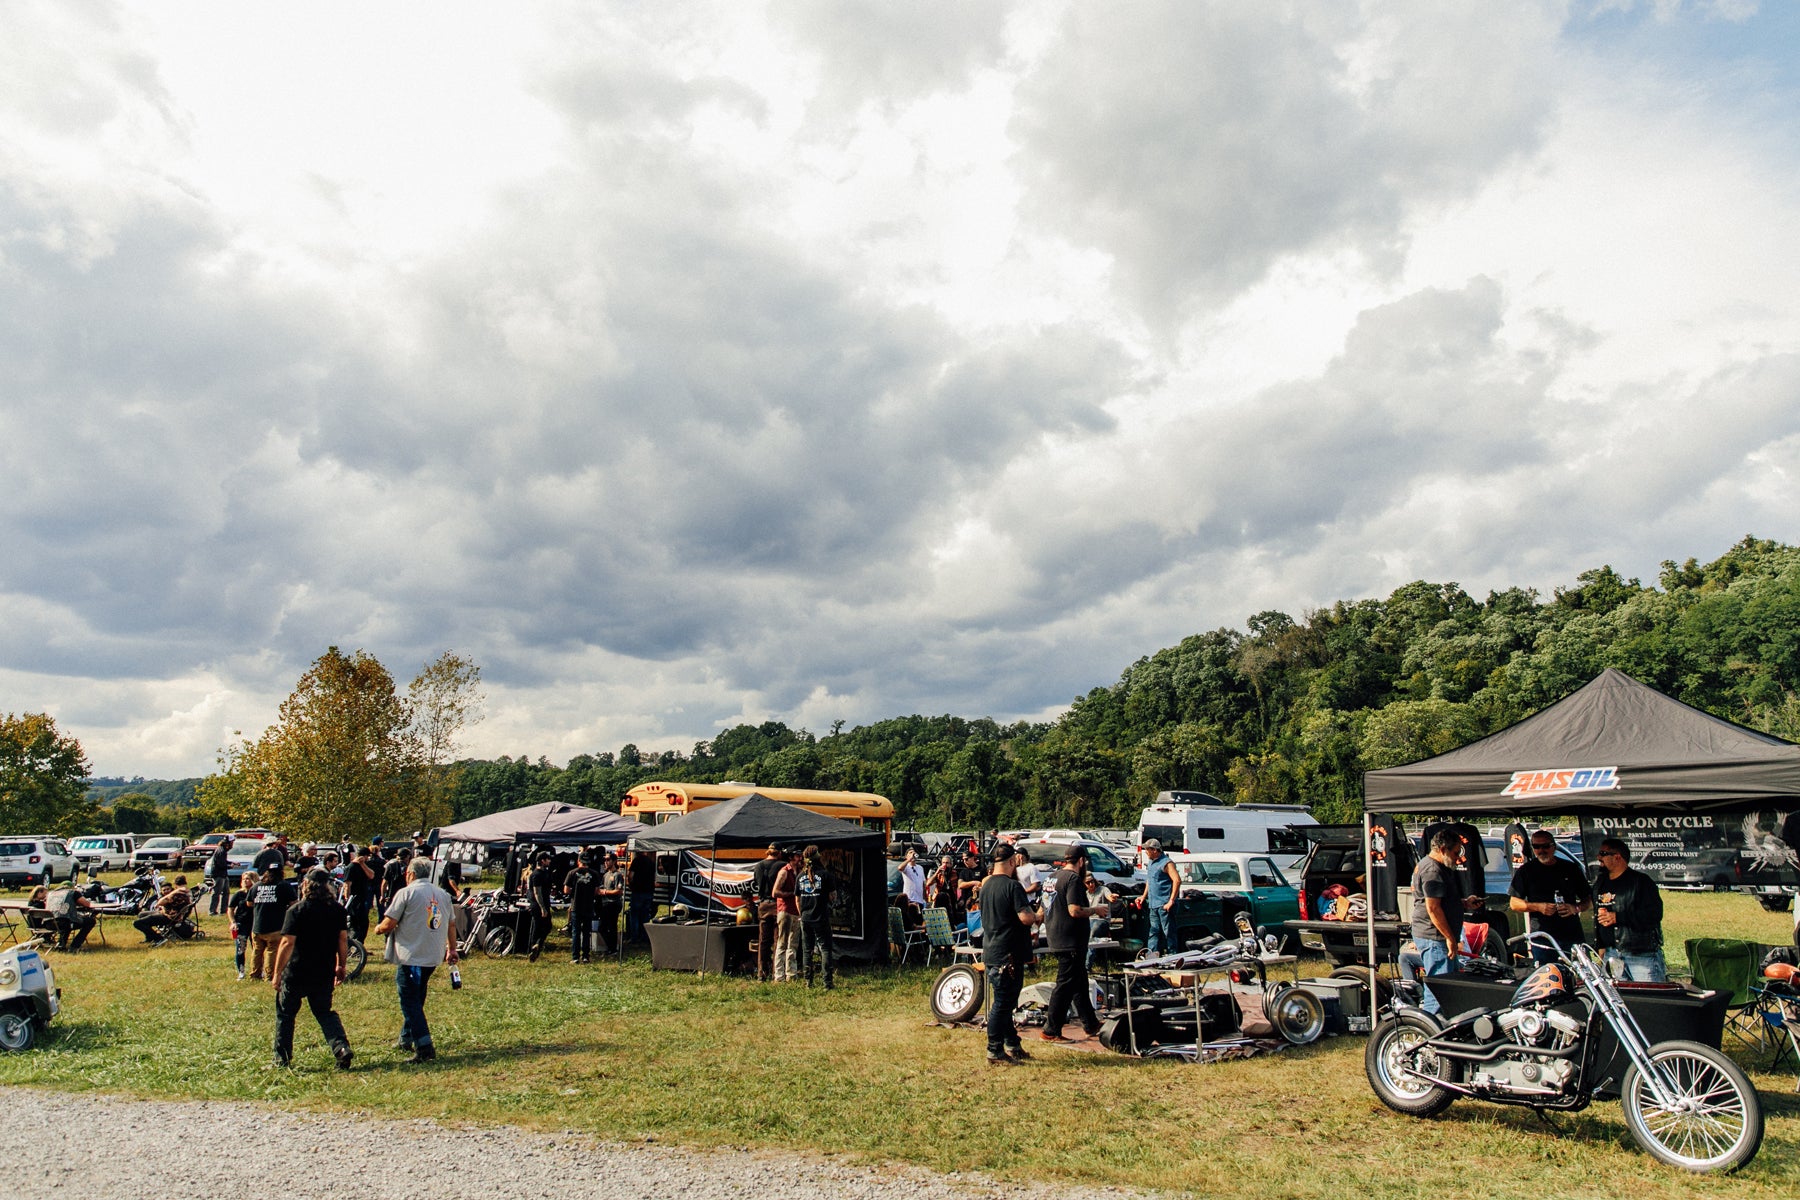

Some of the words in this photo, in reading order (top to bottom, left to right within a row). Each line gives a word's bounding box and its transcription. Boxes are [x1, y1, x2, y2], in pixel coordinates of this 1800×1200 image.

[1506, 769, 1617, 794] AMSOIL
[1593, 817, 1657, 830] ROLL-ON
[1662, 816, 1714, 828] CYCLE
